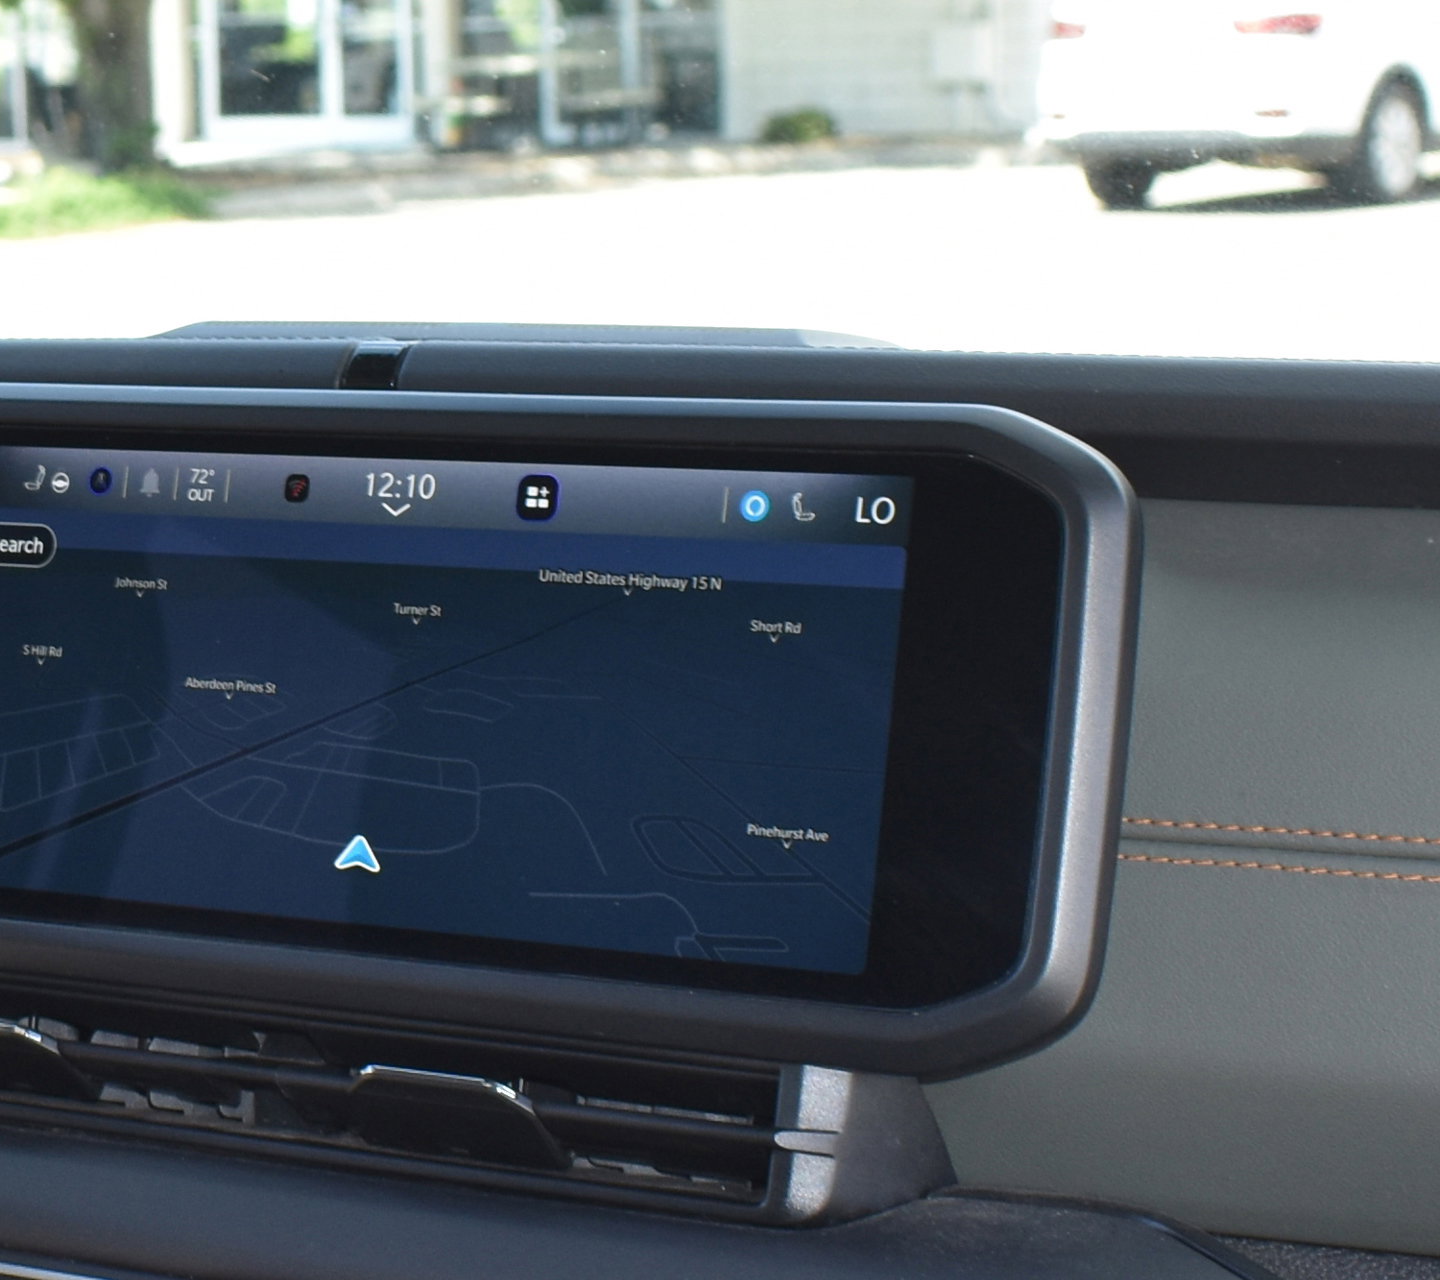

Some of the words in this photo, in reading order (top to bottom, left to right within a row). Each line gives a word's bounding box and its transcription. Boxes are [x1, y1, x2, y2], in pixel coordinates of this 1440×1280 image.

[365, 473, 436, 500] 12:10
[187, 488, 215, 502] OUT
[854, 496, 896, 524] LO
[114, 577, 154, 589] Johnson
[156, 578, 168, 589] St
[539, 569, 582, 583] United
[585, 572, 625, 585] States
[629, 574, 688, 590] Highway
[691, 577, 707, 589] 15
[710, 578, 722, 590] N
[393, 603, 428, 615] Turner
[430, 606, 441, 616] St
[751, 619, 782, 632] Short
[784, 622, 802, 633] Rd
[23, 645, 30, 655] S
[32, 646, 48, 655] Hill
[49, 647, 63, 657] Rd
[184, 677, 234, 689] Aberdeen
[236, 680, 263, 692] Pines
[265, 682, 277, 694] St
[747, 823, 804, 840] Pinehurst
[805, 828, 829, 841] Ave
